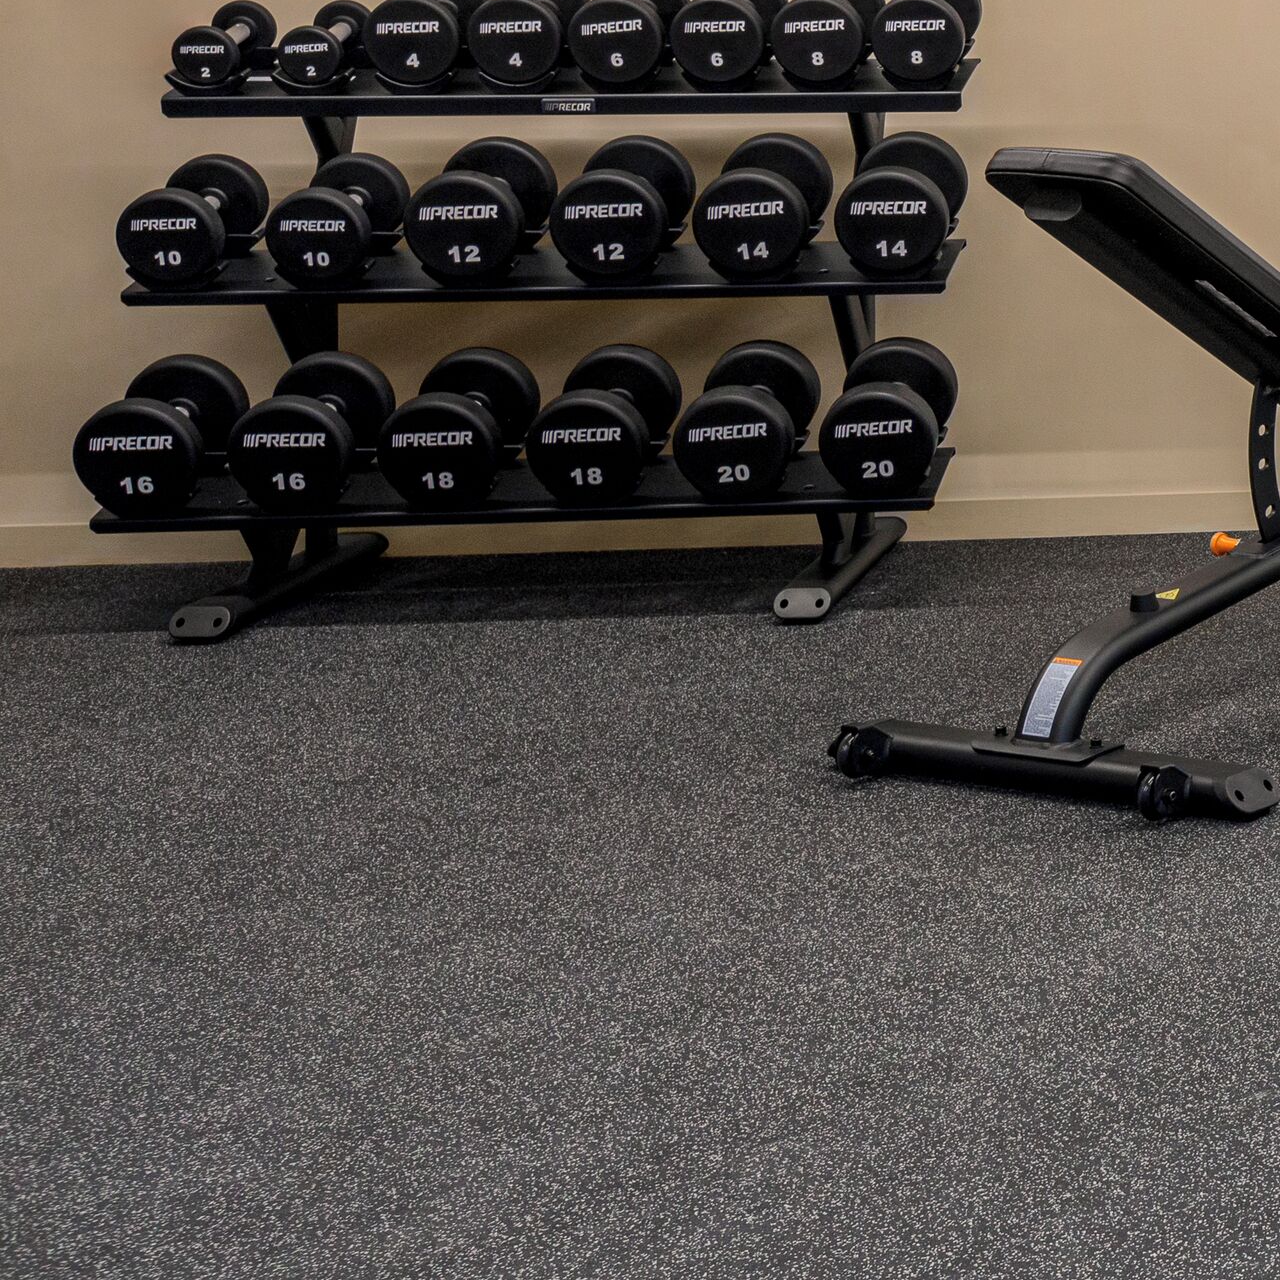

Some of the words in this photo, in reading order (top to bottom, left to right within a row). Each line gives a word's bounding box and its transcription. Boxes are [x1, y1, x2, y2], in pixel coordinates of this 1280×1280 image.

[385, 20, 440, 35] PRECOR
[488, 20, 542, 34] PRECOR
[590, 18, 643, 36] PRECOR
[693, 20, 746, 34] PRECOR
[793, 18, 845, 34] PRECOR
[894, 19, 946, 32] PRECOR
[186, 45, 225, 55] PRECOR
[291, 42, 329, 54] PRECOR
[406, 53, 420, 68] 4
[508, 52, 523, 67] 4
[610, 52, 624, 67] 6
[710, 52, 724, 67] 6
[811, 51, 825, 66] 8
[910, 50, 924, 65] 8
[200, 67, 211, 78] 2
[305, 65, 317, 77] 2
[551, 102, 592, 112] PRECOR
[429, 204, 498, 221] PRECOR
[575, 202, 643, 220] PRECOR
[718, 200, 784, 221] PRECOR
[860, 200, 927, 216] PRECOR
[139, 217, 197, 232] PRECOR
[288, 219, 346, 232] PRECOR
[448, 245, 481, 263] 12
[592, 242, 625, 261] 12
[736, 241, 770, 261] 14
[875, 239, 908, 257] 14
[154, 250, 182, 266] 10
[302, 251, 330, 267] 10
[552, 427, 622, 444] PRECOR
[699, 422, 768, 443] PRECOR
[845, 419, 913, 439] PRECOR
[100, 435, 173, 452] PRECOR
[255, 433, 326, 448] PRECOR
[403, 431, 473, 448] PRECOR
[570, 467, 603, 486] 18
[717, 464, 750, 484] 20
[861, 459, 894, 479] 20
[119, 476, 154, 495] 16
[272, 472, 306, 491] 16
[421, 471, 455, 490] 18
